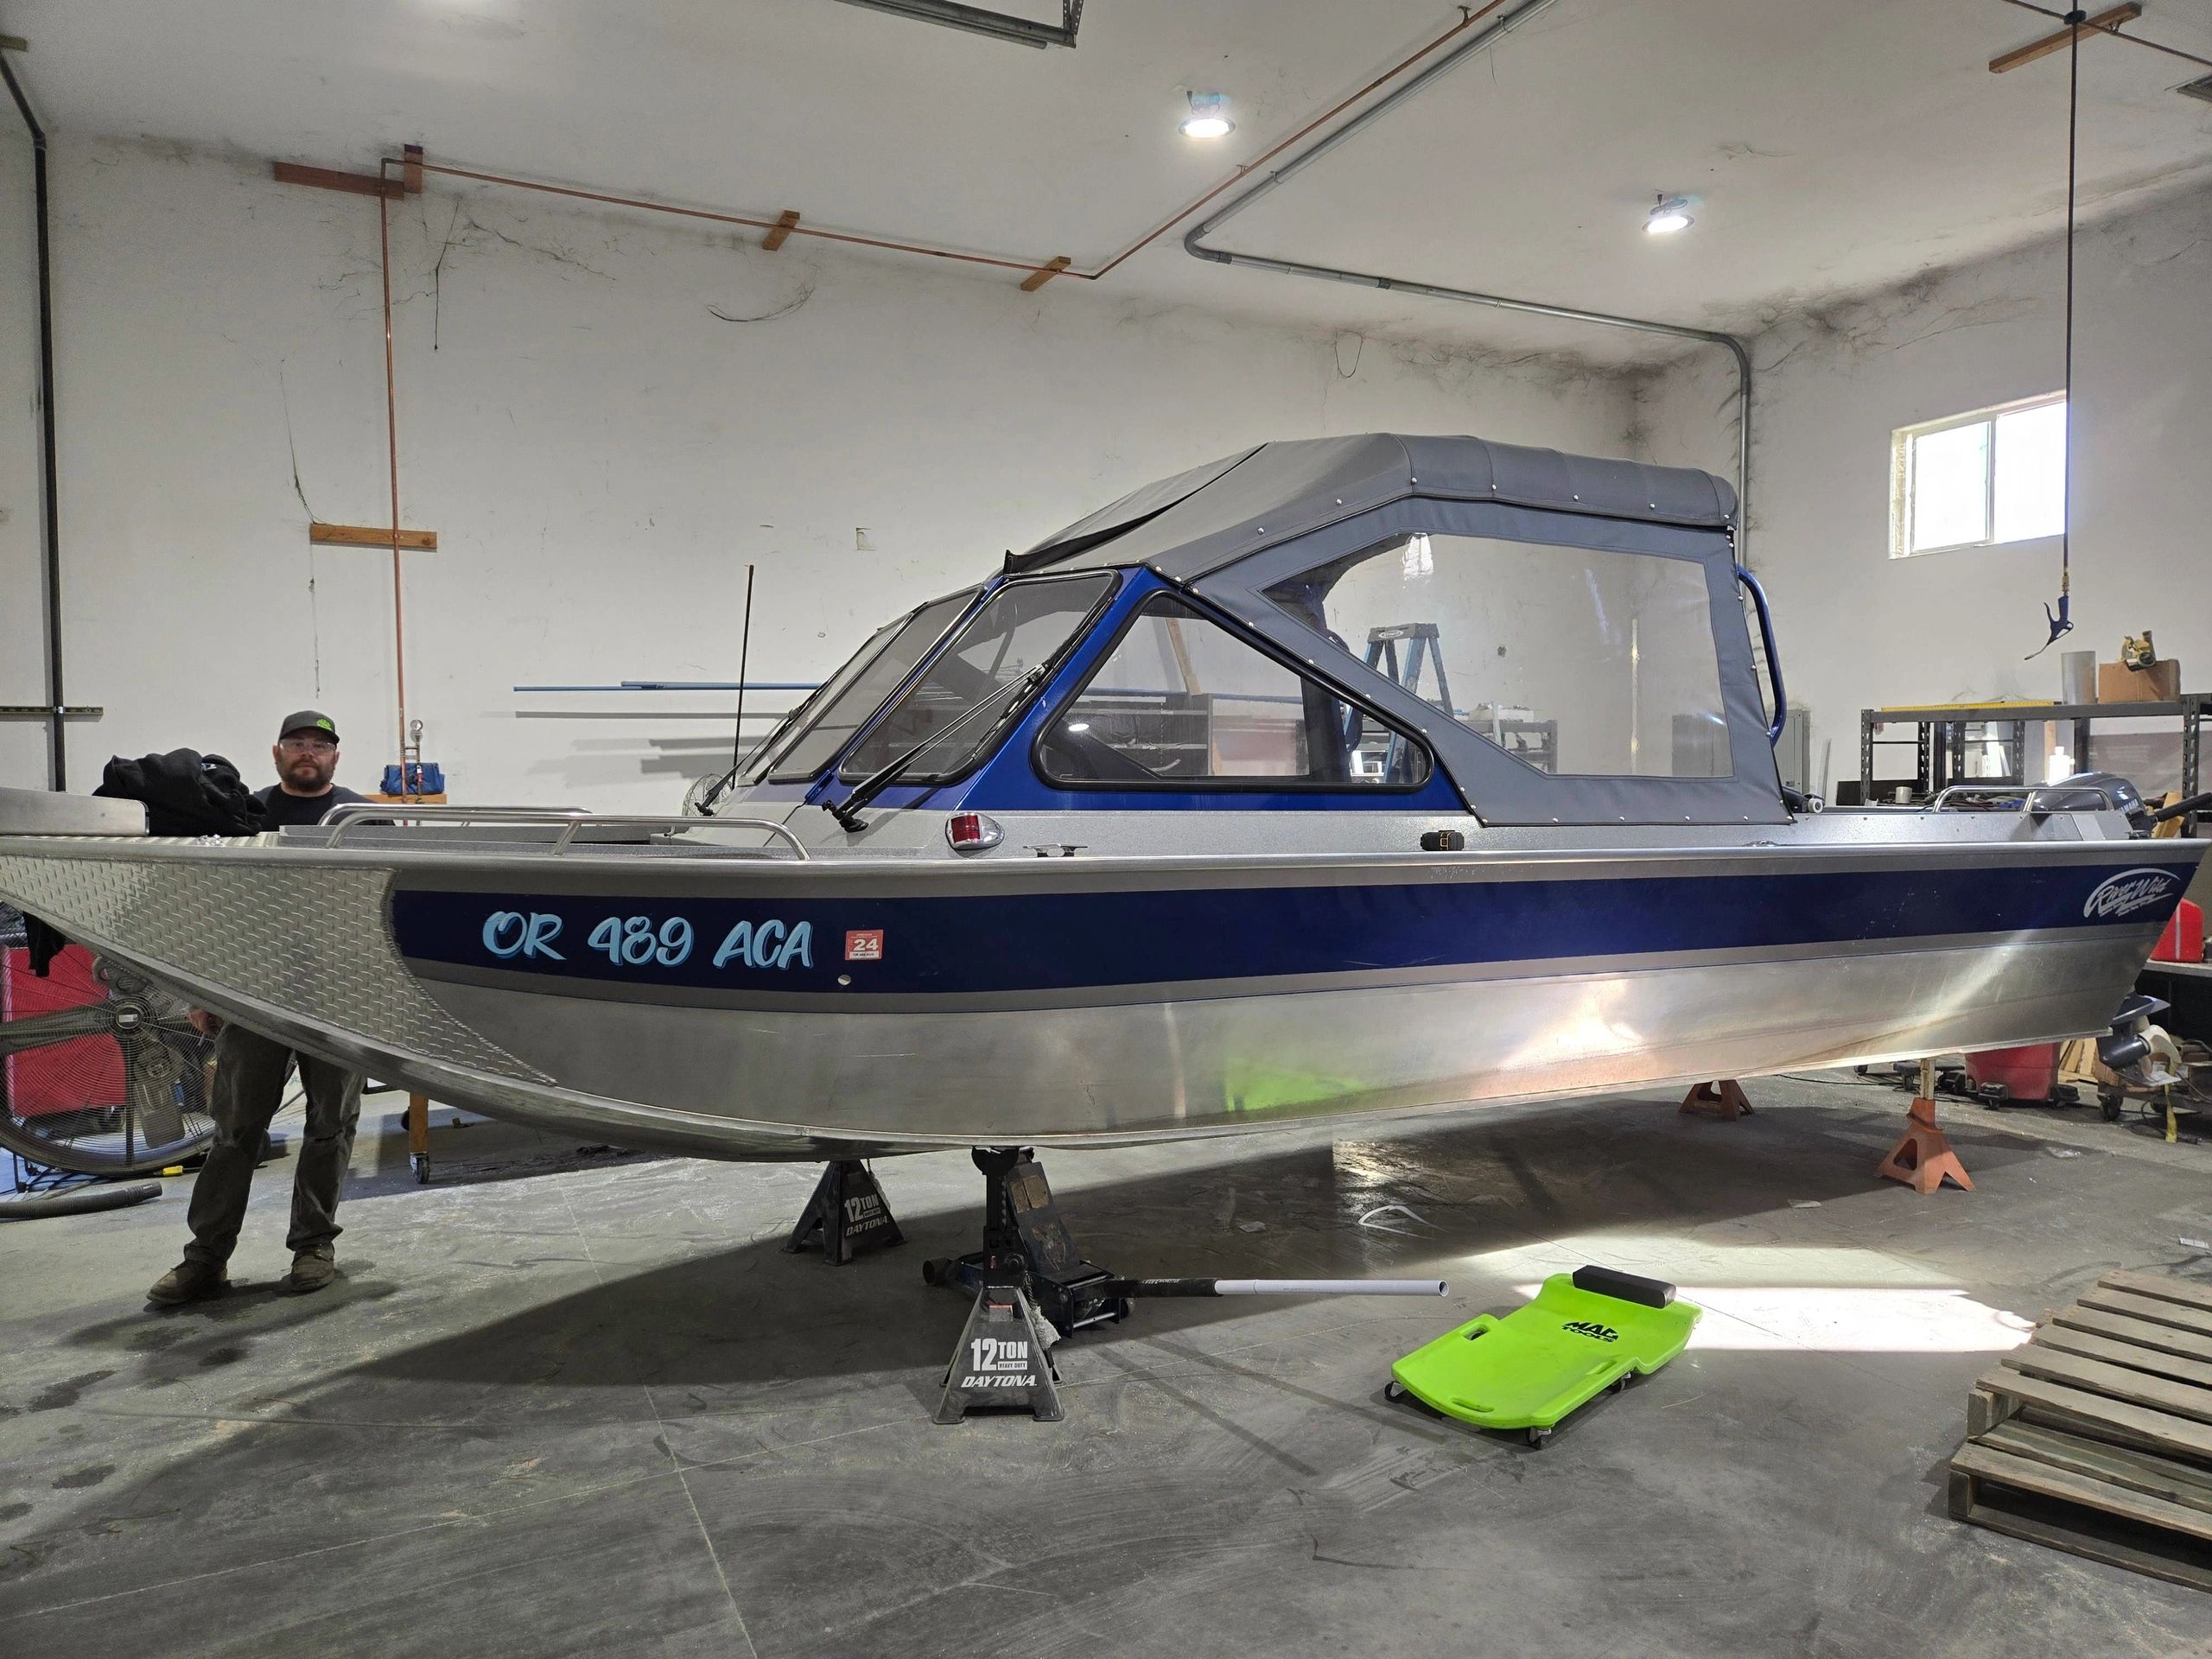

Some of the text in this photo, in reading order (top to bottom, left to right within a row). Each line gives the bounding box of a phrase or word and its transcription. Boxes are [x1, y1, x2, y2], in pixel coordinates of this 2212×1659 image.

[482, 911, 813, 969] OR 489 ACA
[853, 938, 879, 951] 24
[844, 1197, 864, 1223] 12
[860, 1194, 880, 1210] TON
[846, 1216, 888, 1236] DAYTONA
[1564, 1321, 1619, 1341] MAC
[970, 1338, 1028, 1371] 12 TON
[961, 1375, 1036, 1388] DAYTONA
